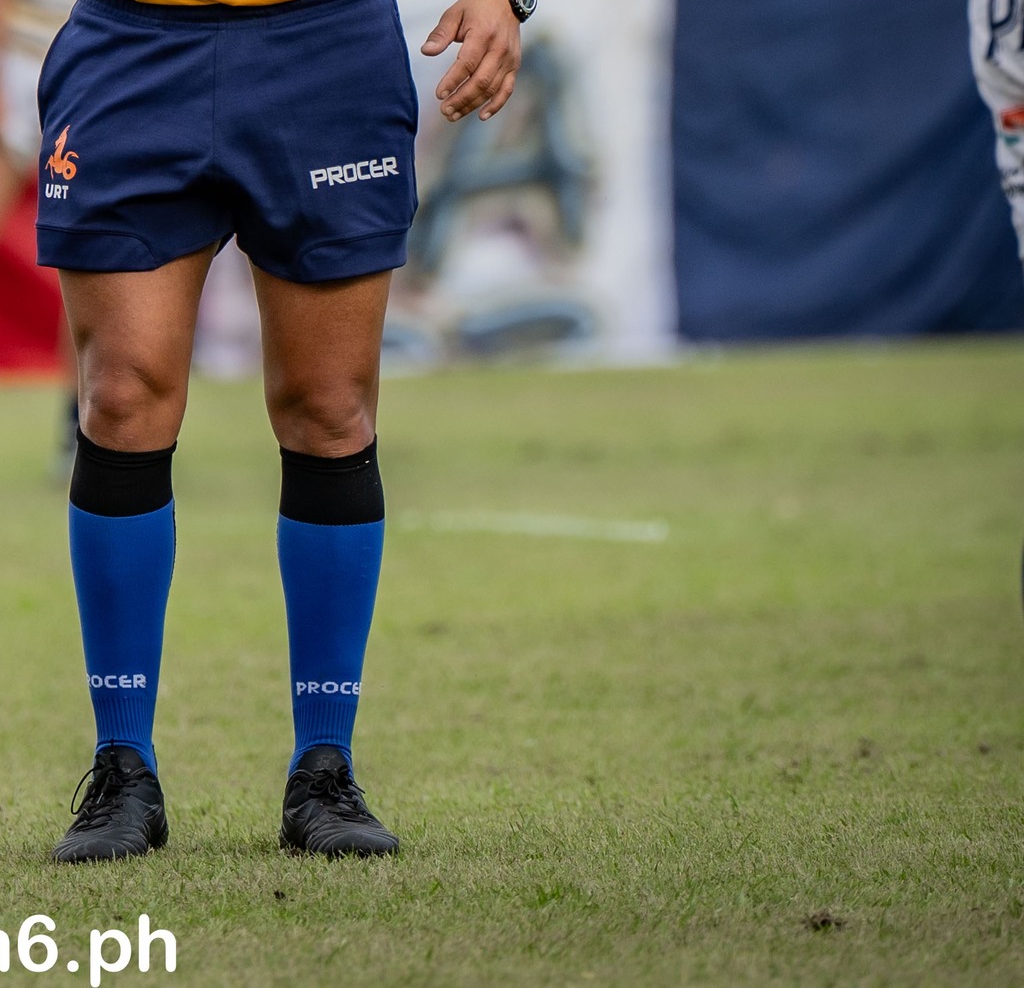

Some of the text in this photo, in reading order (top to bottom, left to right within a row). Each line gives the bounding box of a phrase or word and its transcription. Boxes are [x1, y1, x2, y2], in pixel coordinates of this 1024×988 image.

[309, 156, 400, 190] PROCER
[45, 183, 69, 199] URT
[87, 673, 147, 689] OCER
[296, 681, 362, 696] PROCE
